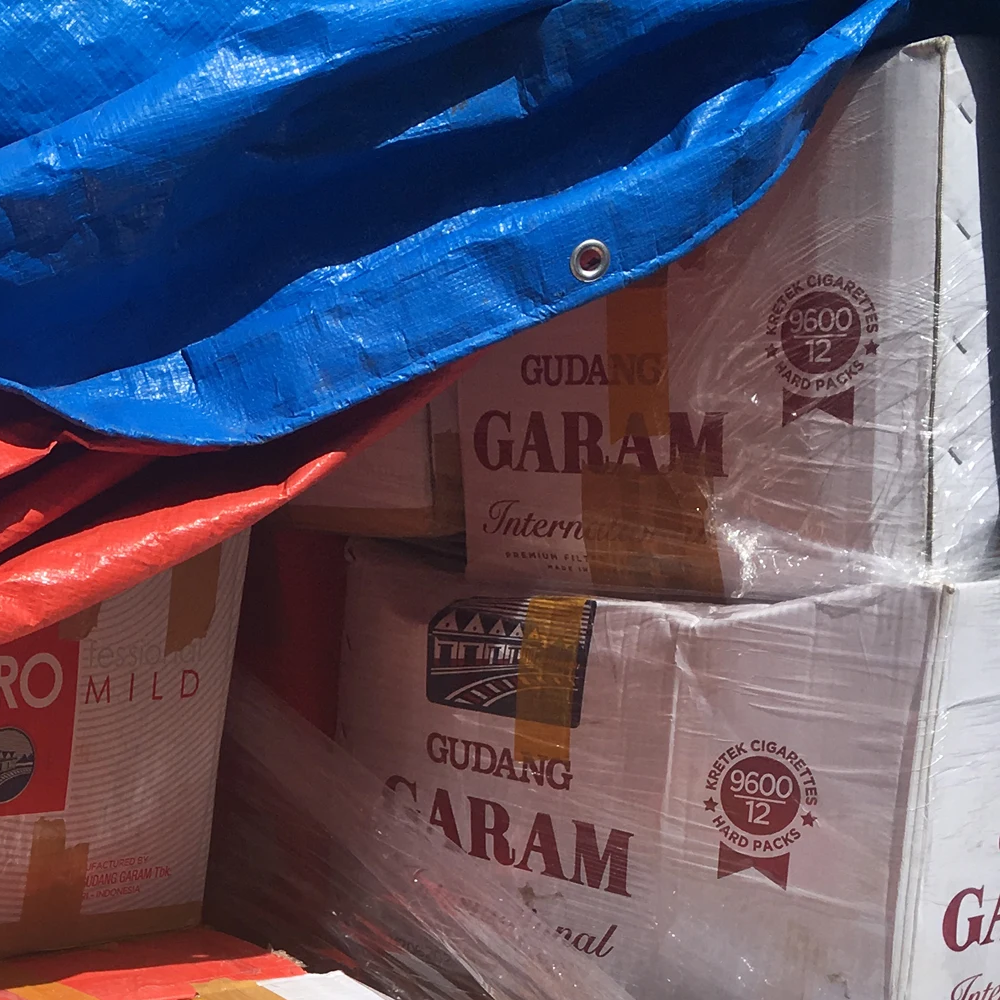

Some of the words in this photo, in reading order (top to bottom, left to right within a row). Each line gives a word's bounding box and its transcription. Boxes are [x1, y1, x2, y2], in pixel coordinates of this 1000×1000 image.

[765, 280, 804, 336] KRETEK
[806, 274, 879, 334] CIGARETTES
[789, 307, 853, 333] 9600
[805, 338, 832, 363] 12
[520, 354, 663, 387] GUDANG
[774, 361, 811, 390] HARD
[815, 360, 865, 391] PACKS
[473, 409, 729, 478] GARAM
[85, 669, 200, 704] MILD
[426, 732, 574, 791] GUDANG
[705, 742, 748, 790] KRETEK
[750, 739, 818, 806] CIGARETTES
[730, 769, 793, 799] 9600
[745, 800, 771, 826] 12
[712, 815, 749, 848] HARD
[752, 828, 801, 852] PACKS
[84, 872, 117, 888] UDANG
[119, 868, 153, 883] GARAM
[96, 885, 141, 899] INDONESIA
